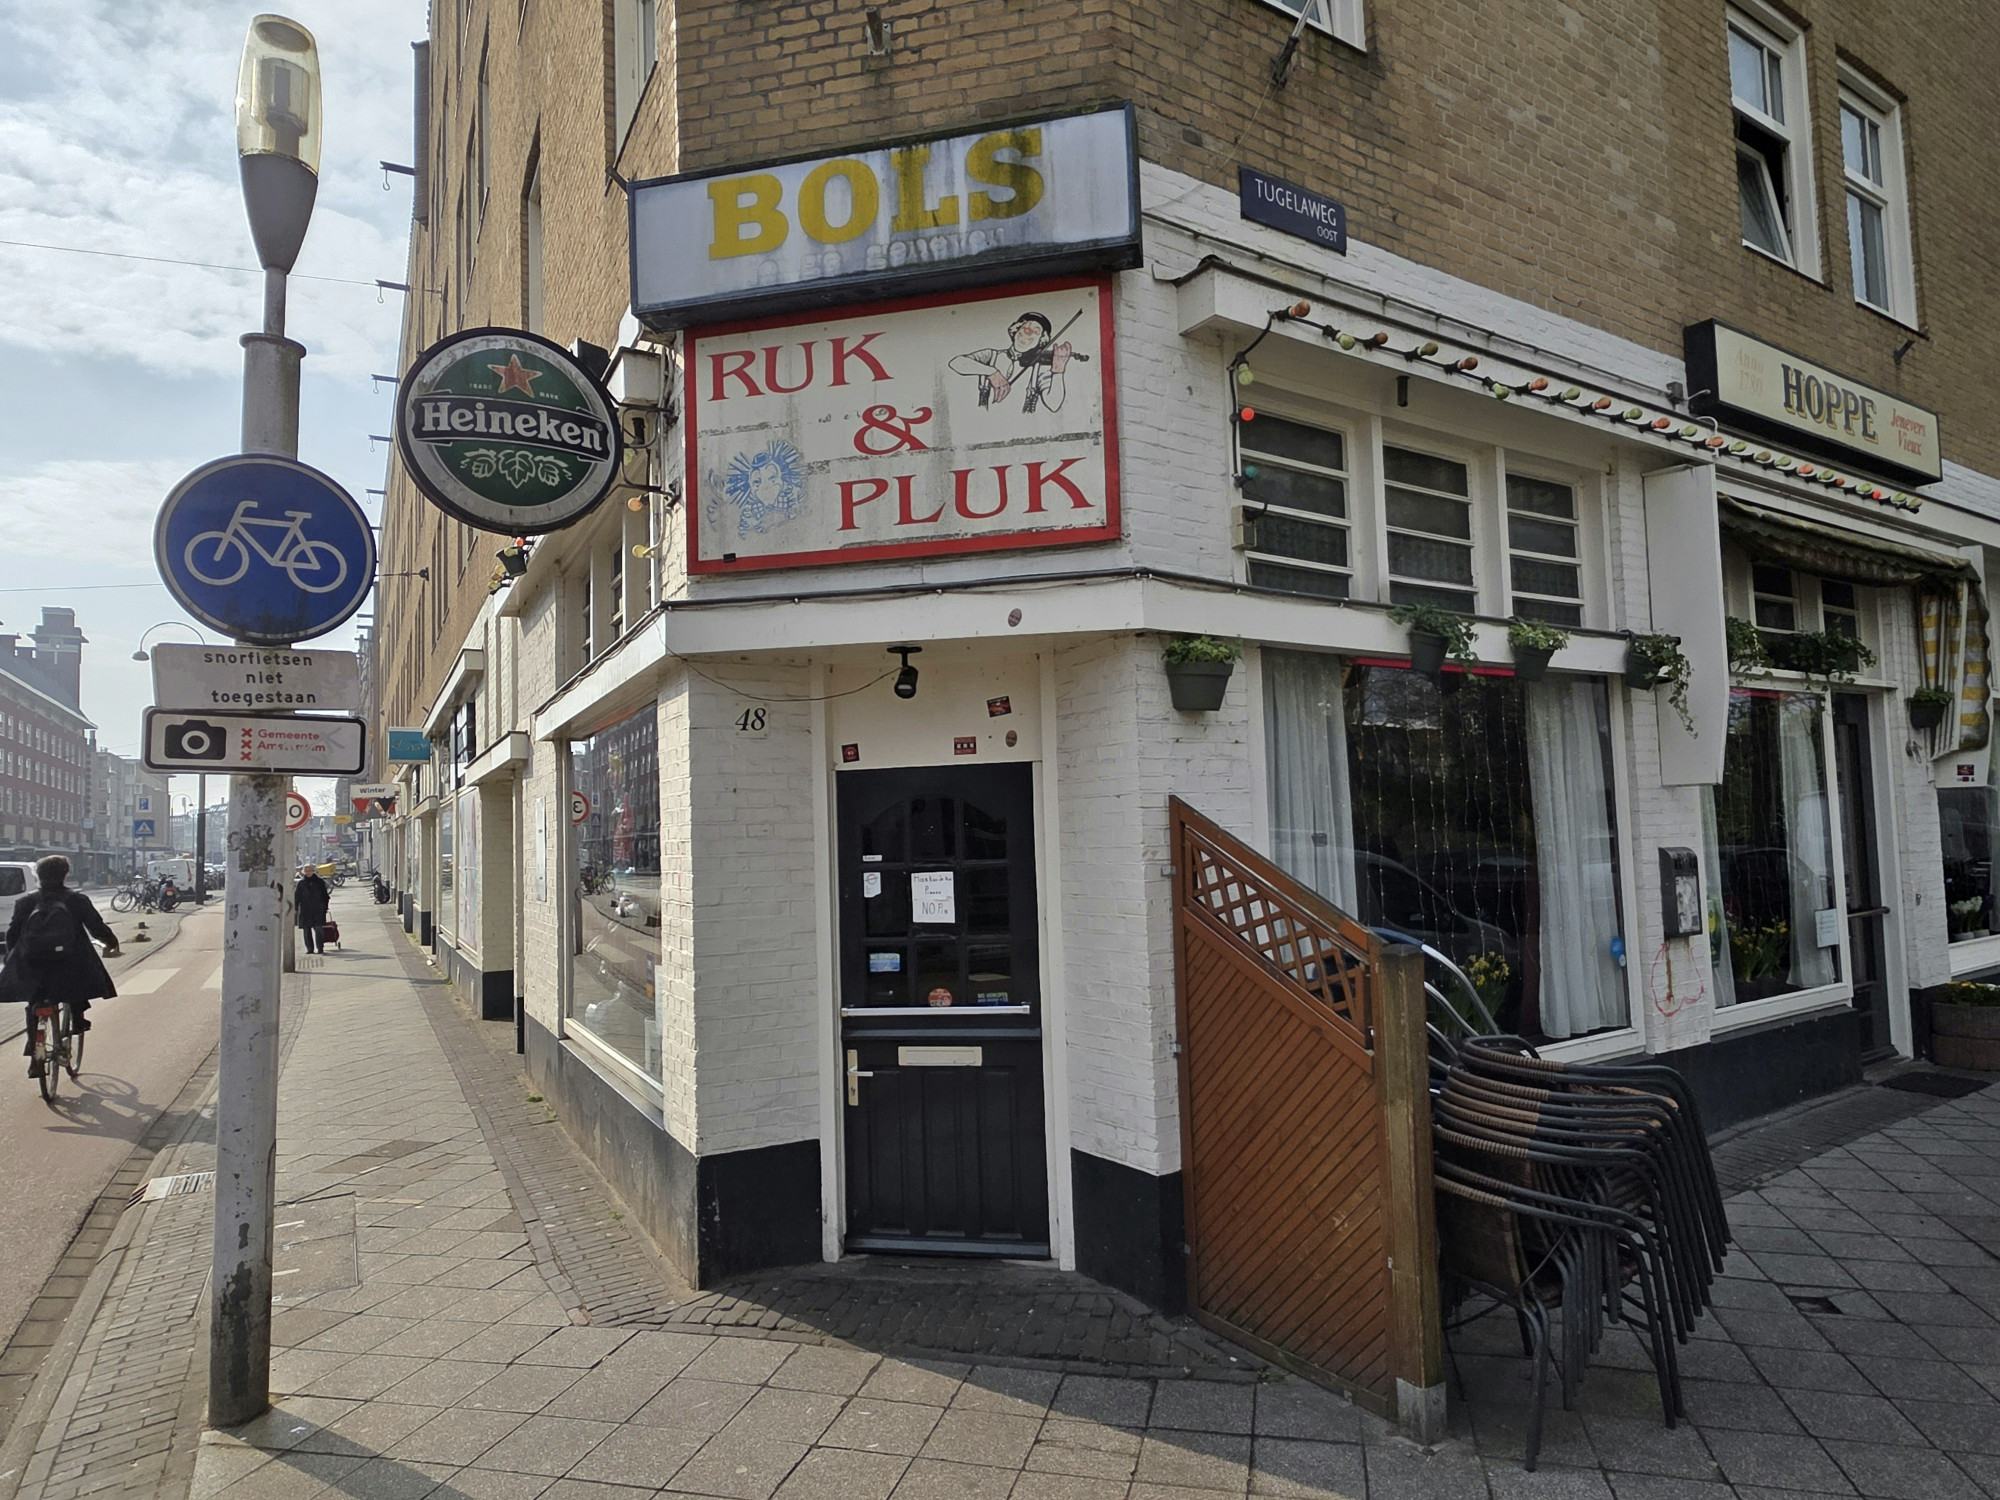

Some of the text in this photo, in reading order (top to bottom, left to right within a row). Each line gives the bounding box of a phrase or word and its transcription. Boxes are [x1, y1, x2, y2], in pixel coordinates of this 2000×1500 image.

[707, 128, 1045, 261] BOLS
[1254, 178, 1337, 226] TUGELAWEG
[1316, 225, 1338, 242] OOST
[706, 332, 895, 402] RUK
[1780, 363, 1879, 445] HOPPE
[421, 402, 602, 451] Heineken
[853, 404, 933, 456] &
[835, 456, 1097, 532] PLUK
[203, 651, 313, 666] snorfietsen
[245, 671, 284, 684] niet
[211, 690, 317, 707] toegestaan
[735, 707, 767, 732] 48
[257, 728, 320, 740] Gemeente
[359, 786, 387, 794] Winter
[289, 804, 302, 818] 0
